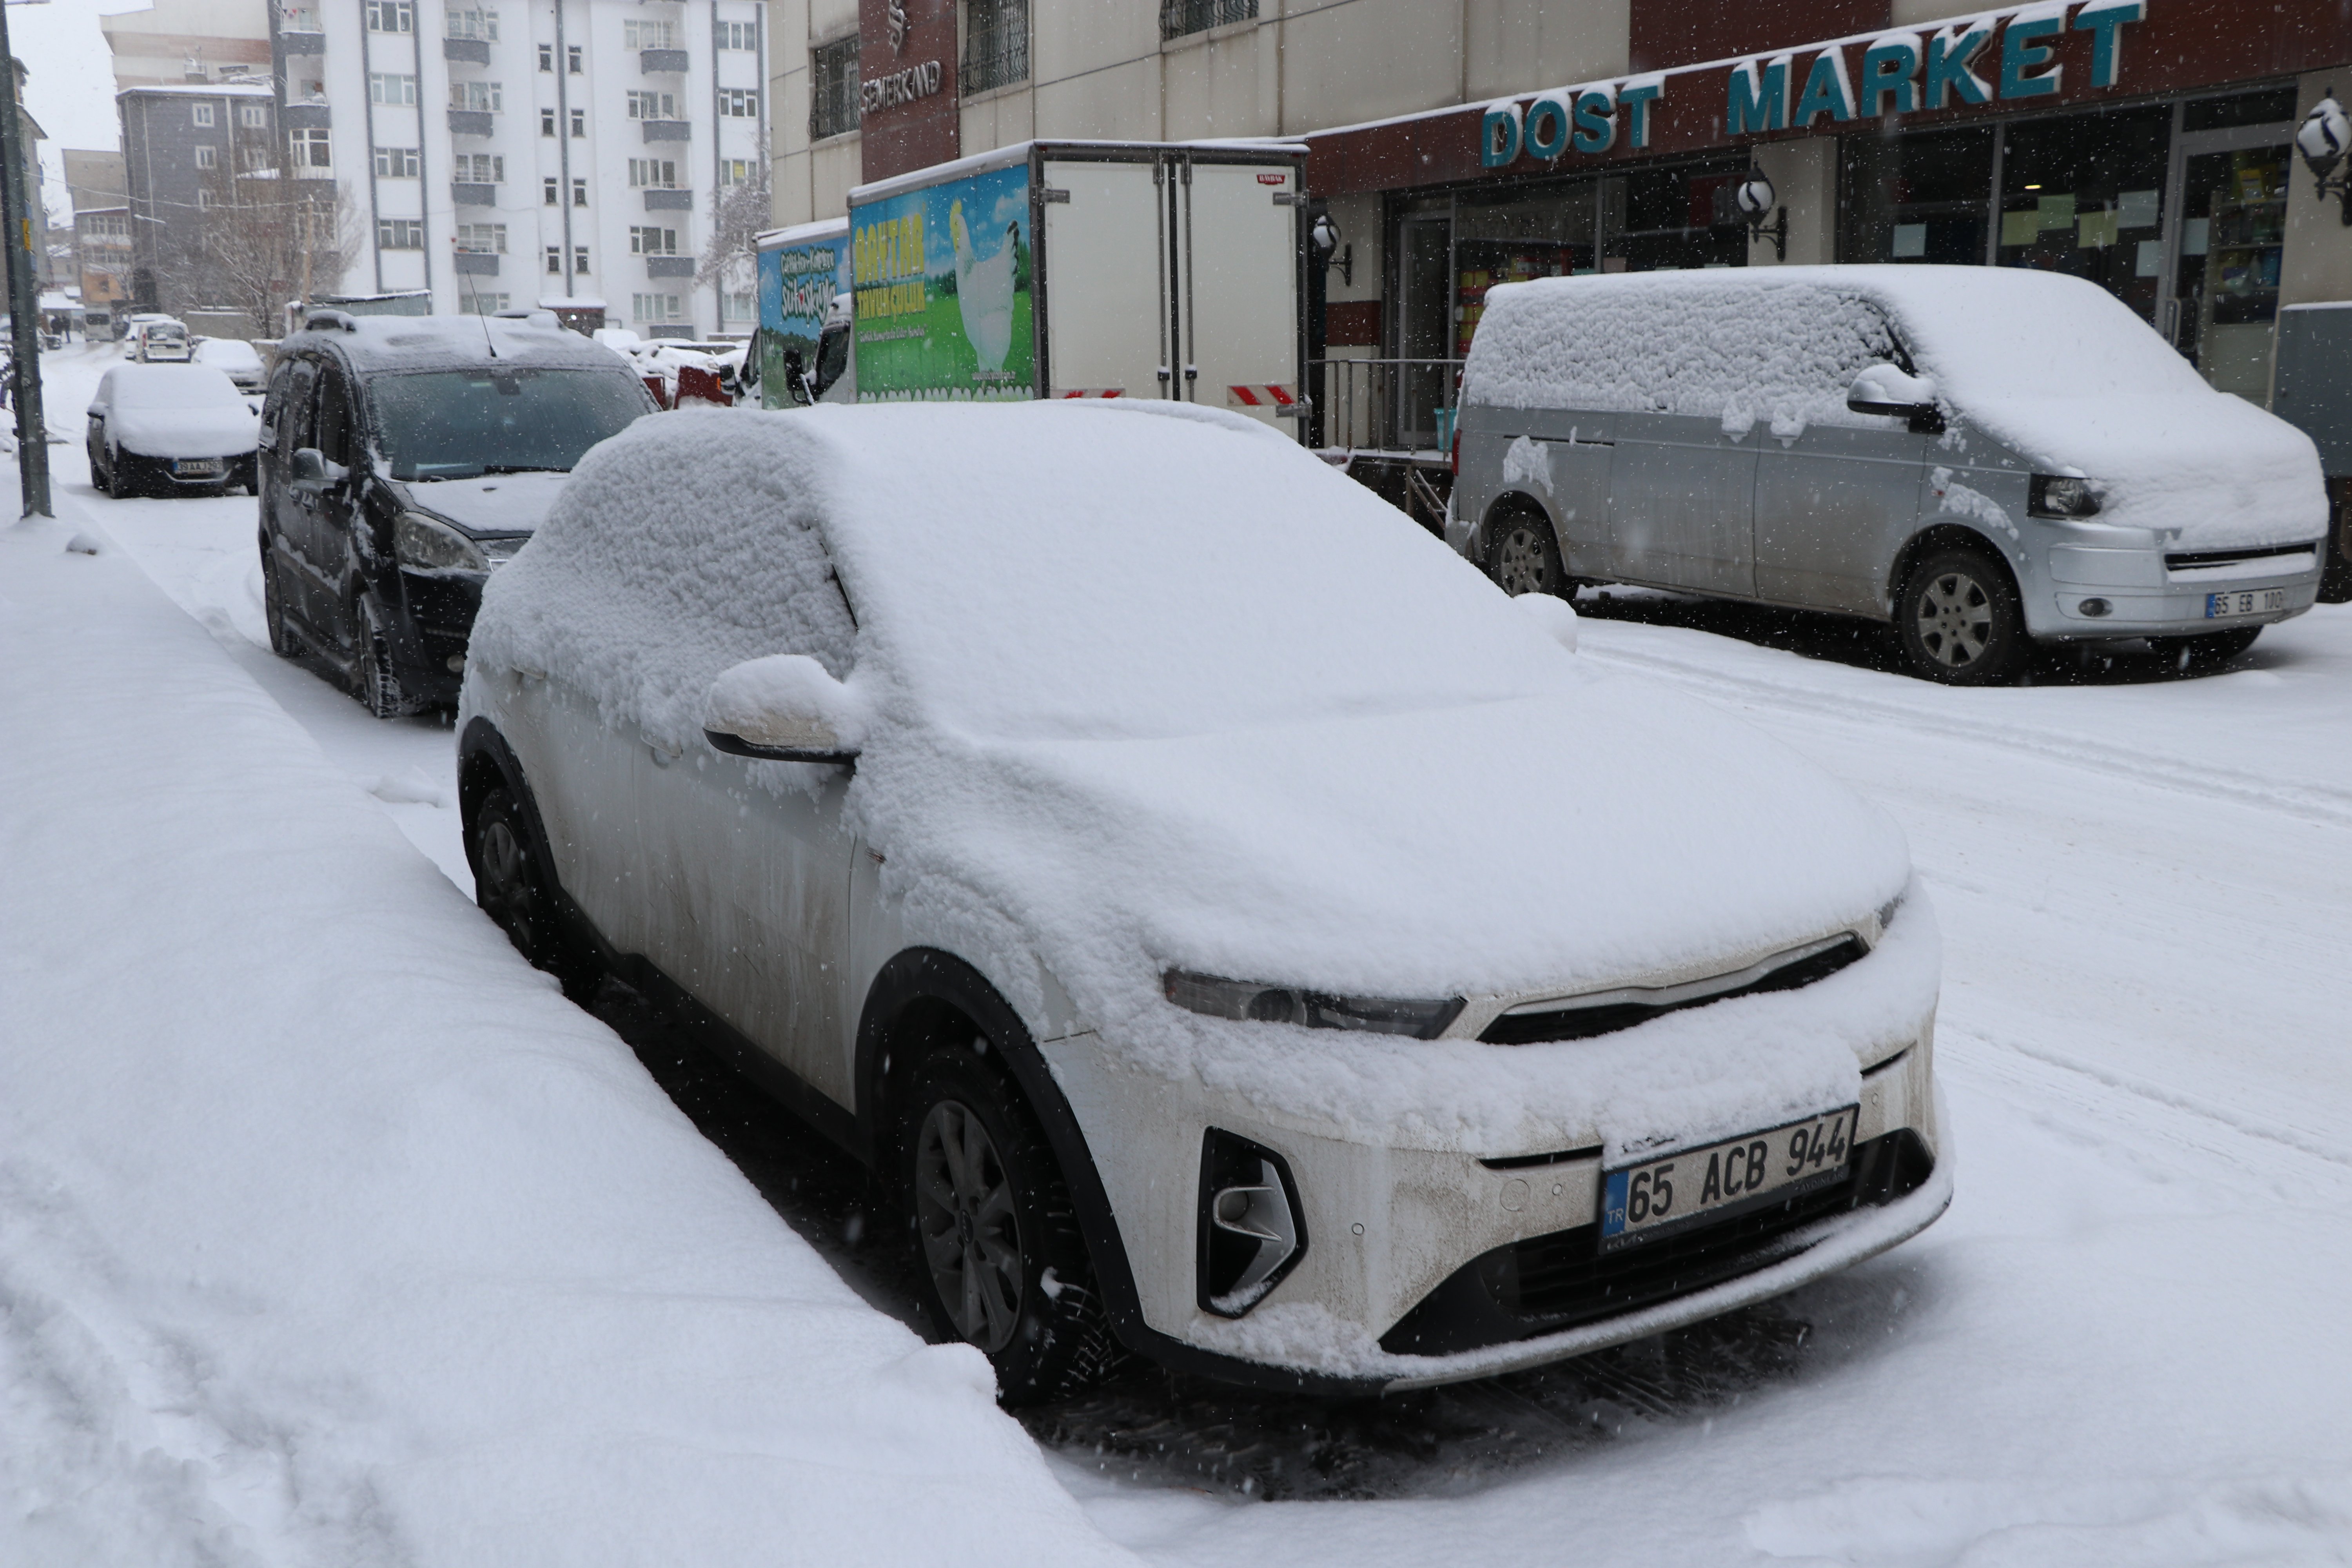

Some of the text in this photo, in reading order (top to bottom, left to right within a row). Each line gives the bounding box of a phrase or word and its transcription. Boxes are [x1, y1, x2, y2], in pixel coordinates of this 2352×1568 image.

[861, 60, 942, 115] SEMERKAND
[1482, 2, 2145, 168] DOST MARKET
[855, 213, 924, 284] BAYTAR
[857, 280, 926, 324] TAVUKÇULUK
[2214, 596, 2229, 614] 65
[2239, 593, 2253, 612] EB
[1628, 1116, 1846, 1223] 65 ACB 944
[1606, 1207, 1624, 1225] TR
